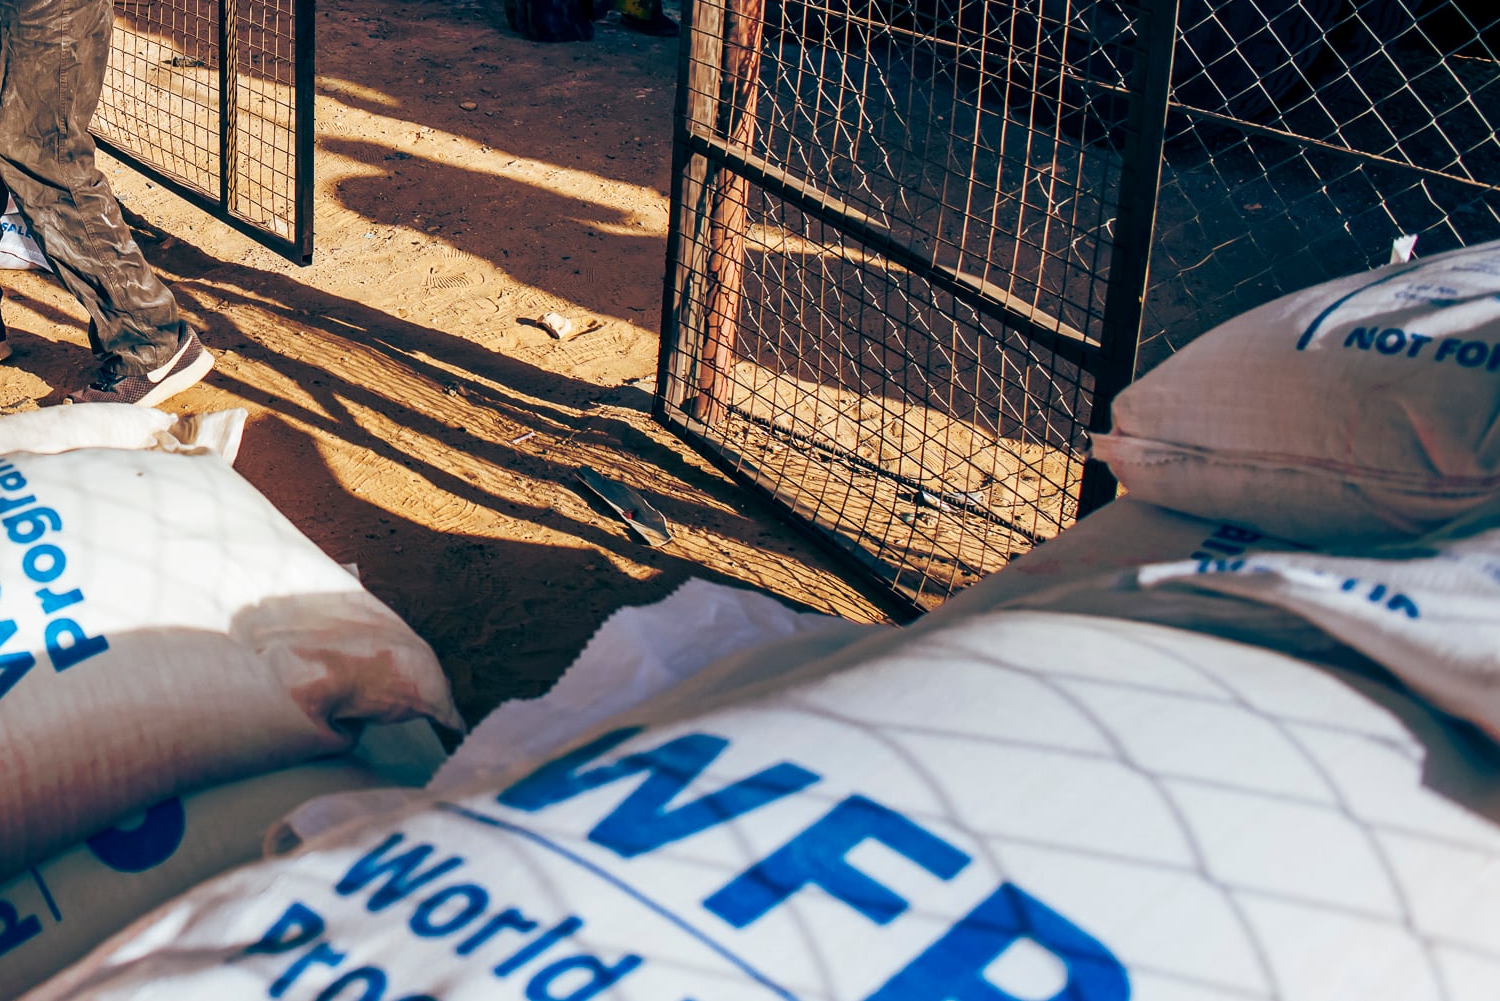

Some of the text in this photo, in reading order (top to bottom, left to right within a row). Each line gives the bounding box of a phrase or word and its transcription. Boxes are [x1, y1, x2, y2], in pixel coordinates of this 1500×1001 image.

[1343, 326, 1433, 358] NOT
[334, 832, 644, 1001] World
[496, 724, 1132, 1001] WFP
[244, 901, 440, 1001] Pro
